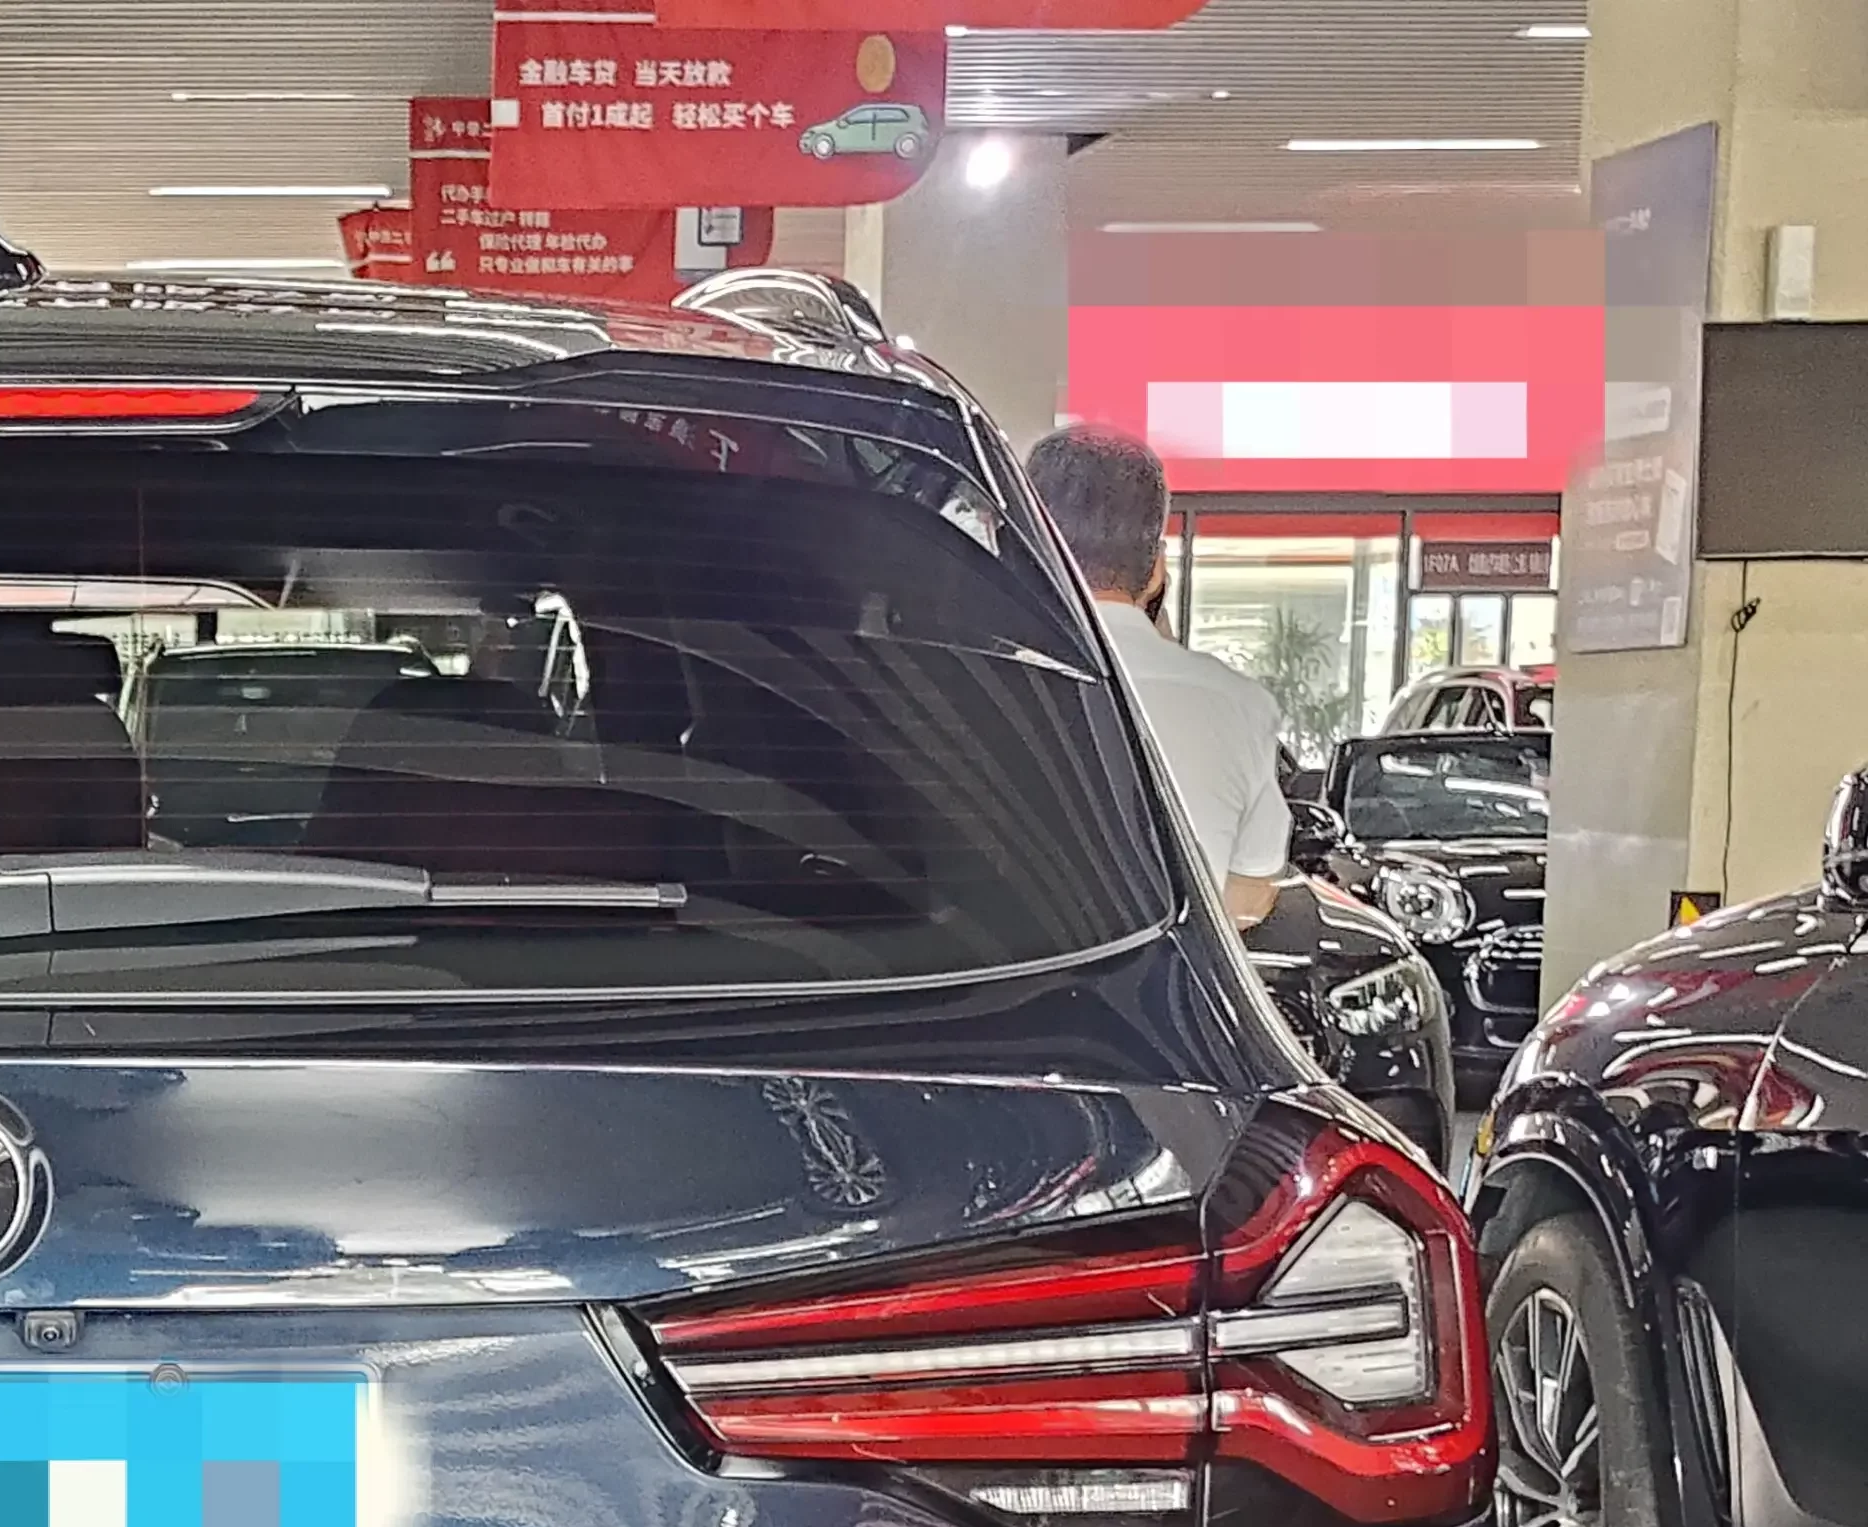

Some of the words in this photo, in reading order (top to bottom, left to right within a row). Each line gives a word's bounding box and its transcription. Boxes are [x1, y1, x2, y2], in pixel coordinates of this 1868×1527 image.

[518, 59, 618, 87] 金融车贷
[634, 59, 732, 88] 当天放款
[542, 102, 654, 130] 首付1成起
[672, 102, 795, 130] 轻松买个车
